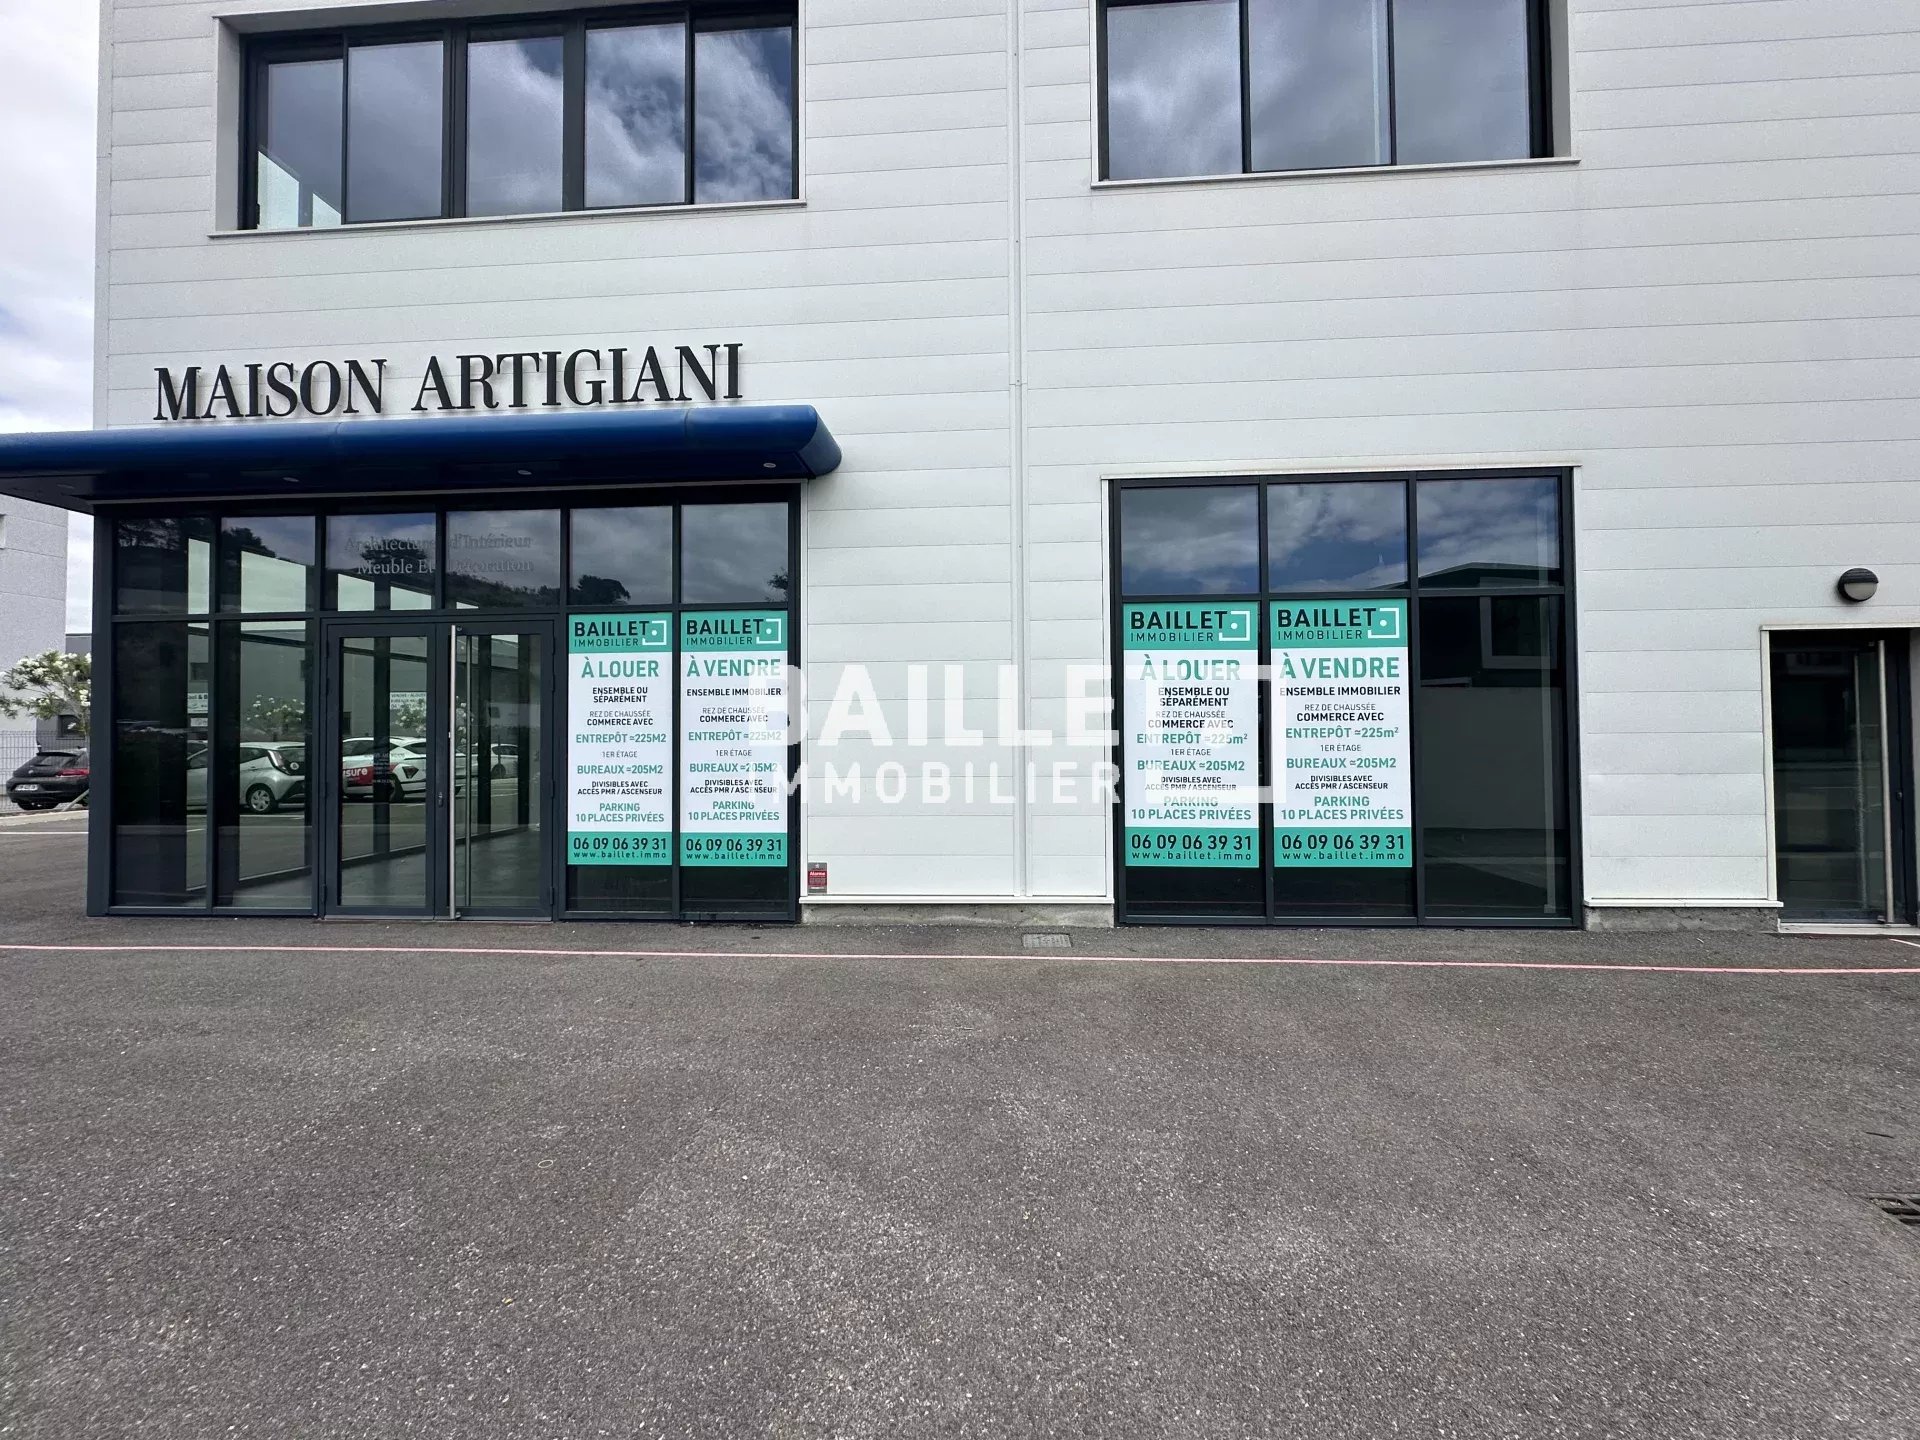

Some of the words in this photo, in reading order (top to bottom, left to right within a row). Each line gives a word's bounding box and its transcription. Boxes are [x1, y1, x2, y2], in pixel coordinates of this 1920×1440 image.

[153, 359, 387, 421] MAISON
[411, 343, 744, 410] ARTIGIANI
[357, 559, 413, 575] Meuble
[1131, 612, 1228, 630] BAILLET
[1278, 609, 1377, 627] BAILLET
[574, 621, 650, 637] BAILLET
[687, 619, 764, 635] BAILLET
[1131, 632, 1214, 642] IMMOBILIER
[1278, 630, 1362, 640] IMMOBILIER
[574, 638, 638, 647] IMMOBILIER
[687, 637, 752, 645] IMMOBILIER
[581, 656, 594, 678] À
[599, 660, 659, 677] LOUER
[687, 655, 700, 677] À
[704, 659, 781, 676] VENDRE
[1140, 654, 1157, 680] À
[1163, 660, 1240, 680] LOUER
[1280, 653, 1297, 679] À
[1301, 657, 1400, 678] VENDRE
[687, 688, 730, 696] ENSEMBLE
[732, 688, 782, 696] IMMOBILIER
[1159, 687, 1212, 696] ENSEMBLE
[1215, 687, 1229, 695] OU
[1280, 687, 1335, 696] ENSEMBLE
[1337, 686, 1400, 695] IMMOBILIER
[593, 694, 646, 703] SÉPARÉMENT
[1160, 696, 1228, 706] SÉPARÉMENT
[729, 706, 765, 714] CHAUSSÉE
[1334, 702, 1376, 711] CHAUSSÉE
[614, 709, 650, 717] CHAUSSÉE
[1184, 710, 1225, 718] CHAUSSÉE
[1297, 713, 1356, 721] COMMERCE
[1357, 712, 1384, 721] AVEC
[700, 715, 745, 723] COMMERCE
[1148, 720, 1205, 728] COMMERCE
[1207, 720, 1234, 728] AVEC
[689, 729, 742, 740] ENTREPÔT
[1286, 725, 1351, 738] ENTREPÔT
[576, 731, 627, 743] ENTREPÔT
[1137, 731, 1201, 744] ENTREPÔT
[730, 748, 752, 757] ÉTAGE
[1187, 747, 1211, 756] ÉTAGE
[1337, 743, 1361, 752] ÉTAGE
[616, 749, 637, 758] ÉTAGE
[690, 763, 738, 772] BUREAUX
[1138, 761, 1196, 770] BUREAUX
[1287, 758, 1347, 768] BUREAUX
[577, 765, 624, 774] BUREAUX
[578, 787, 599, 795] ACCÈS
[713, 801, 754, 810] PARKING
[1164, 797, 1218, 807] PARKING
[1314, 797, 1370, 806] PARKING
[600, 803, 640, 812] PARKING
[576, 814, 586, 822] 10
[588, 814, 623, 822] PLACES
[625, 811, 664, 822] PRIVÉES
[688, 812, 699, 820] 10
[701, 812, 737, 820] PLACES
[739, 810, 779, 820] PRIVÉES
[1132, 810, 1145, 819] 10
[1148, 810, 1196, 819] PLACES
[1200, 807, 1251, 820] PRIVÉES
[1281, 810, 1295, 820] 10
[1298, 810, 1347, 820] PLACES
[1350, 806, 1403, 820] PRIVÉES
[574, 838, 589, 850] 06
[593, 838, 609, 849] 09
[612, 838, 628, 849] 06
[632, 838, 648, 849] 39
[652, 838, 666, 849] 31
[686, 839, 702, 851] 06
[706, 839, 722, 851] 09
[726, 839, 742, 851] 06
[747, 839, 762, 851] 39
[767, 840, 782, 851] 31
[1132, 835, 1151, 849] 06
[1157, 835, 1177, 849] 09
[1182, 835, 1202, 849] 06
[1208, 836, 1228, 850] 39
[1234, 836, 1252, 850] 31
[1282, 835, 1302, 849] 06
[1307, 835, 1328, 849] 09
[1333, 835, 1354, 849] 06
[1359, 836, 1380, 849] 39
[1386, 836, 1404, 850] 31
[574, 850, 666, 858] www.baillet.immo
[687, 852, 782, 860] www.baillet.immo
[1132, 851, 1251, 861] www.baillet.immo
[1282, 852, 1404, 861] www.baillet.immo
